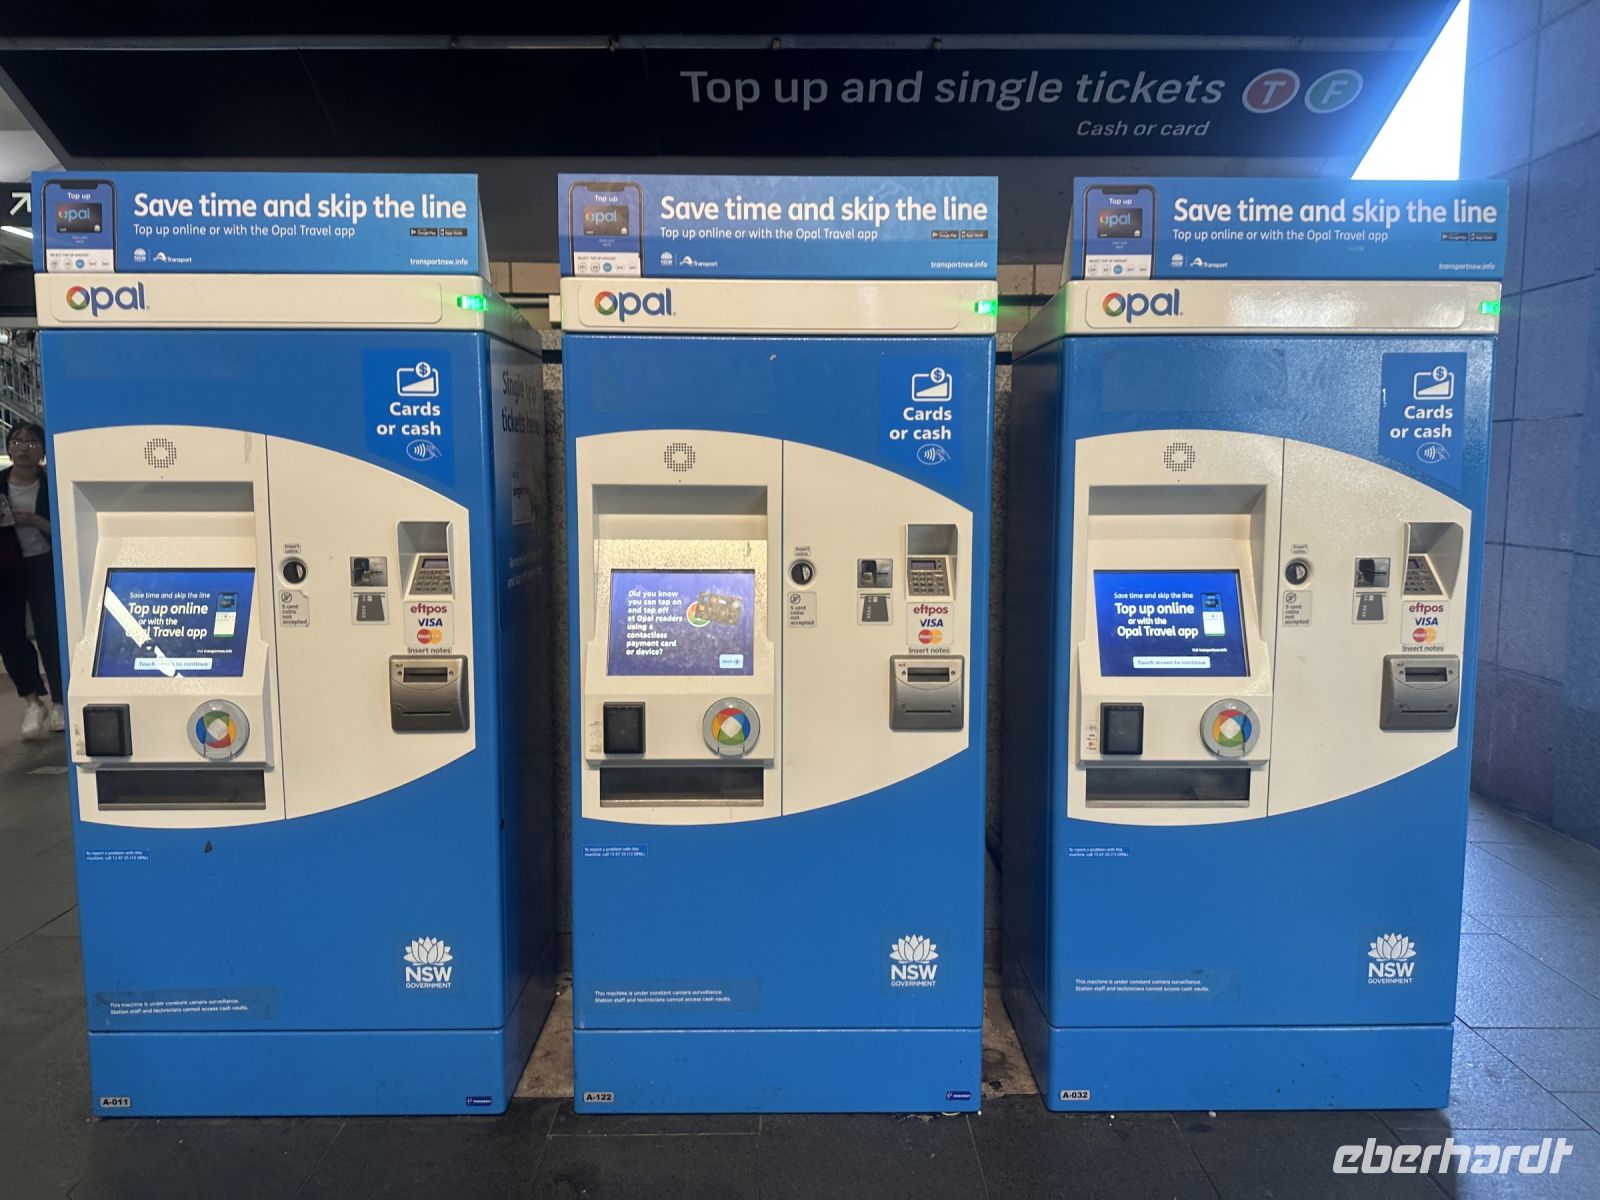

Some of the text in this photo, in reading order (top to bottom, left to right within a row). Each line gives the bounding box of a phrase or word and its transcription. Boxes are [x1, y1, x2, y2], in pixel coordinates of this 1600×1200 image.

[680, 70, 1226, 111] Top up and single tickets
[1077, 120, 1210, 136] Cash or card
[68, 192, 80, 200] Top
[594, 194, 607, 203] Top
[1109, 198, 1122, 206] Top
[134, 192, 467, 224] Save time and skip the line
[661, 195, 988, 228] Save time and skip the line
[1174, 197, 1497, 229] Save time and skip the line
[134, 224, 357, 238] Top up online or with the Opal Travel app
[660, 226, 878, 242] Top up online or with the Opal Travel app
[1173, 228, 1388, 243] Top up online or with the Opal Travel app
[410, 257, 469, 268] transportnsw.info
[930, 260, 988, 270] transportnsw.info
[390, 401, 440, 416] Cards
[903, 406, 952, 421] Cards
[1404, 405, 1453, 419] Cards
[376, 421, 441, 436] or cash
[889, 425, 951, 440] or cash
[1390, 424, 1452, 438] or cash
[174, 592, 187, 600] skip
[128, 602, 208, 617] Top up online
[410, 603, 448, 616] eftpos
[913, 603, 949, 616] eftpos
[1114, 602, 1194, 617] Top up online
[1408, 602, 1444, 615] eftpos
[148, 617, 164, 626] with
[165, 618, 178, 626] the
[418, 618, 443, 627] VISA
[637, 614, 654, 622] Opal
[655, 614, 683, 622] readers
[920, 618, 944, 628] VISA
[1136, 616, 1154, 625] with
[1154, 617, 1167, 625] the
[1415, 617, 1439, 626] VISA
[153, 626, 184, 637] Travel
[186, 628, 207, 640] app
[627, 623, 647, 632] using
[1117, 625, 1199, 639] Opal Travel app
[626, 640, 659, 648] payment
[405, 966, 453, 982] NSW
[890, 964, 938, 980] NSW
[1368, 961, 1415, 978] NSW
